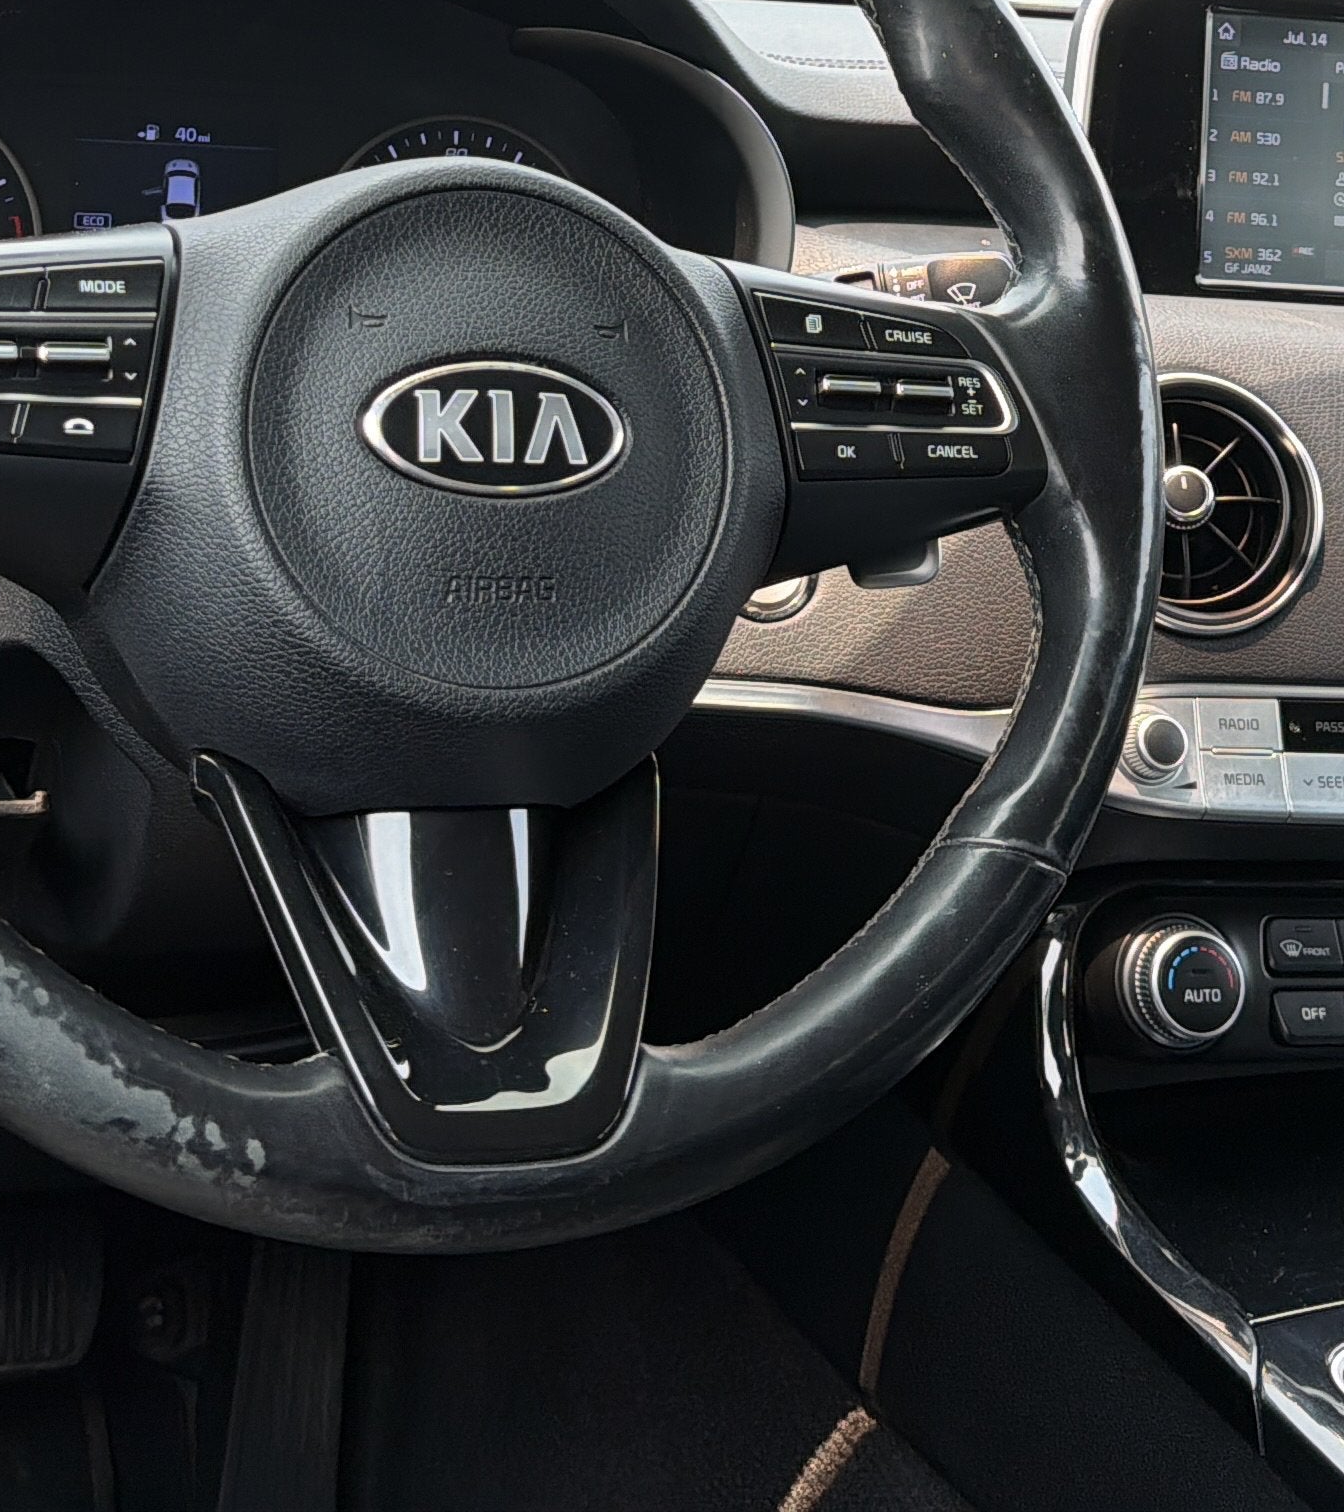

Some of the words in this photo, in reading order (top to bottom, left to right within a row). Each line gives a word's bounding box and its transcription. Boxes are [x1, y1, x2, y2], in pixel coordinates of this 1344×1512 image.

[1310, 32, 1328, 46] 14
[1240, 56, 1281, 73] Radio
[1212, 88, 1219, 101] 1
[1232, 90, 1252, 104] FM
[1256, 91, 1285, 106] 87.9
[1209, 128, 1219, 142] 2
[1230, 131, 1252, 143] AM
[1256, 132, 1281, 146] 530
[1207, 169, 1217, 182] 3
[1228, 170, 1248, 184] FM
[1252, 172, 1280, 186] 92.1
[82, 216, 105, 226] ECO
[1205, 210, 1215, 222] 4
[1226, 211, 1246, 224] FM
[1250, 212, 1278, 227] 96.1
[1203, 251, 1213, 263] 5
[1225, 246, 1253, 260] SXM
[1257, 248, 1282, 262] 362
[1224, 262, 1239, 274] GF
[1241, 263, 1272, 275] JAMZ
[78, 279, 127, 295] MODE
[906, 280, 925, 291] OFF
[885, 328, 933, 345] CRUISE
[958, 376, 982, 389] RES
[961, 403, 984, 416] SET
[414, 389, 588, 465] KIA
[837, 444, 857, 459] OK
[927, 444, 979, 459] CANCEL
[1218, 716, 1260, 731] RADIO
[1223, 772, 1266, 787] MEDIA
[1302, 946, 1332, 957] FRONT
[1183, 988, 1222, 1004] AUTO
[1301, 1007, 1327, 1021] OFF
